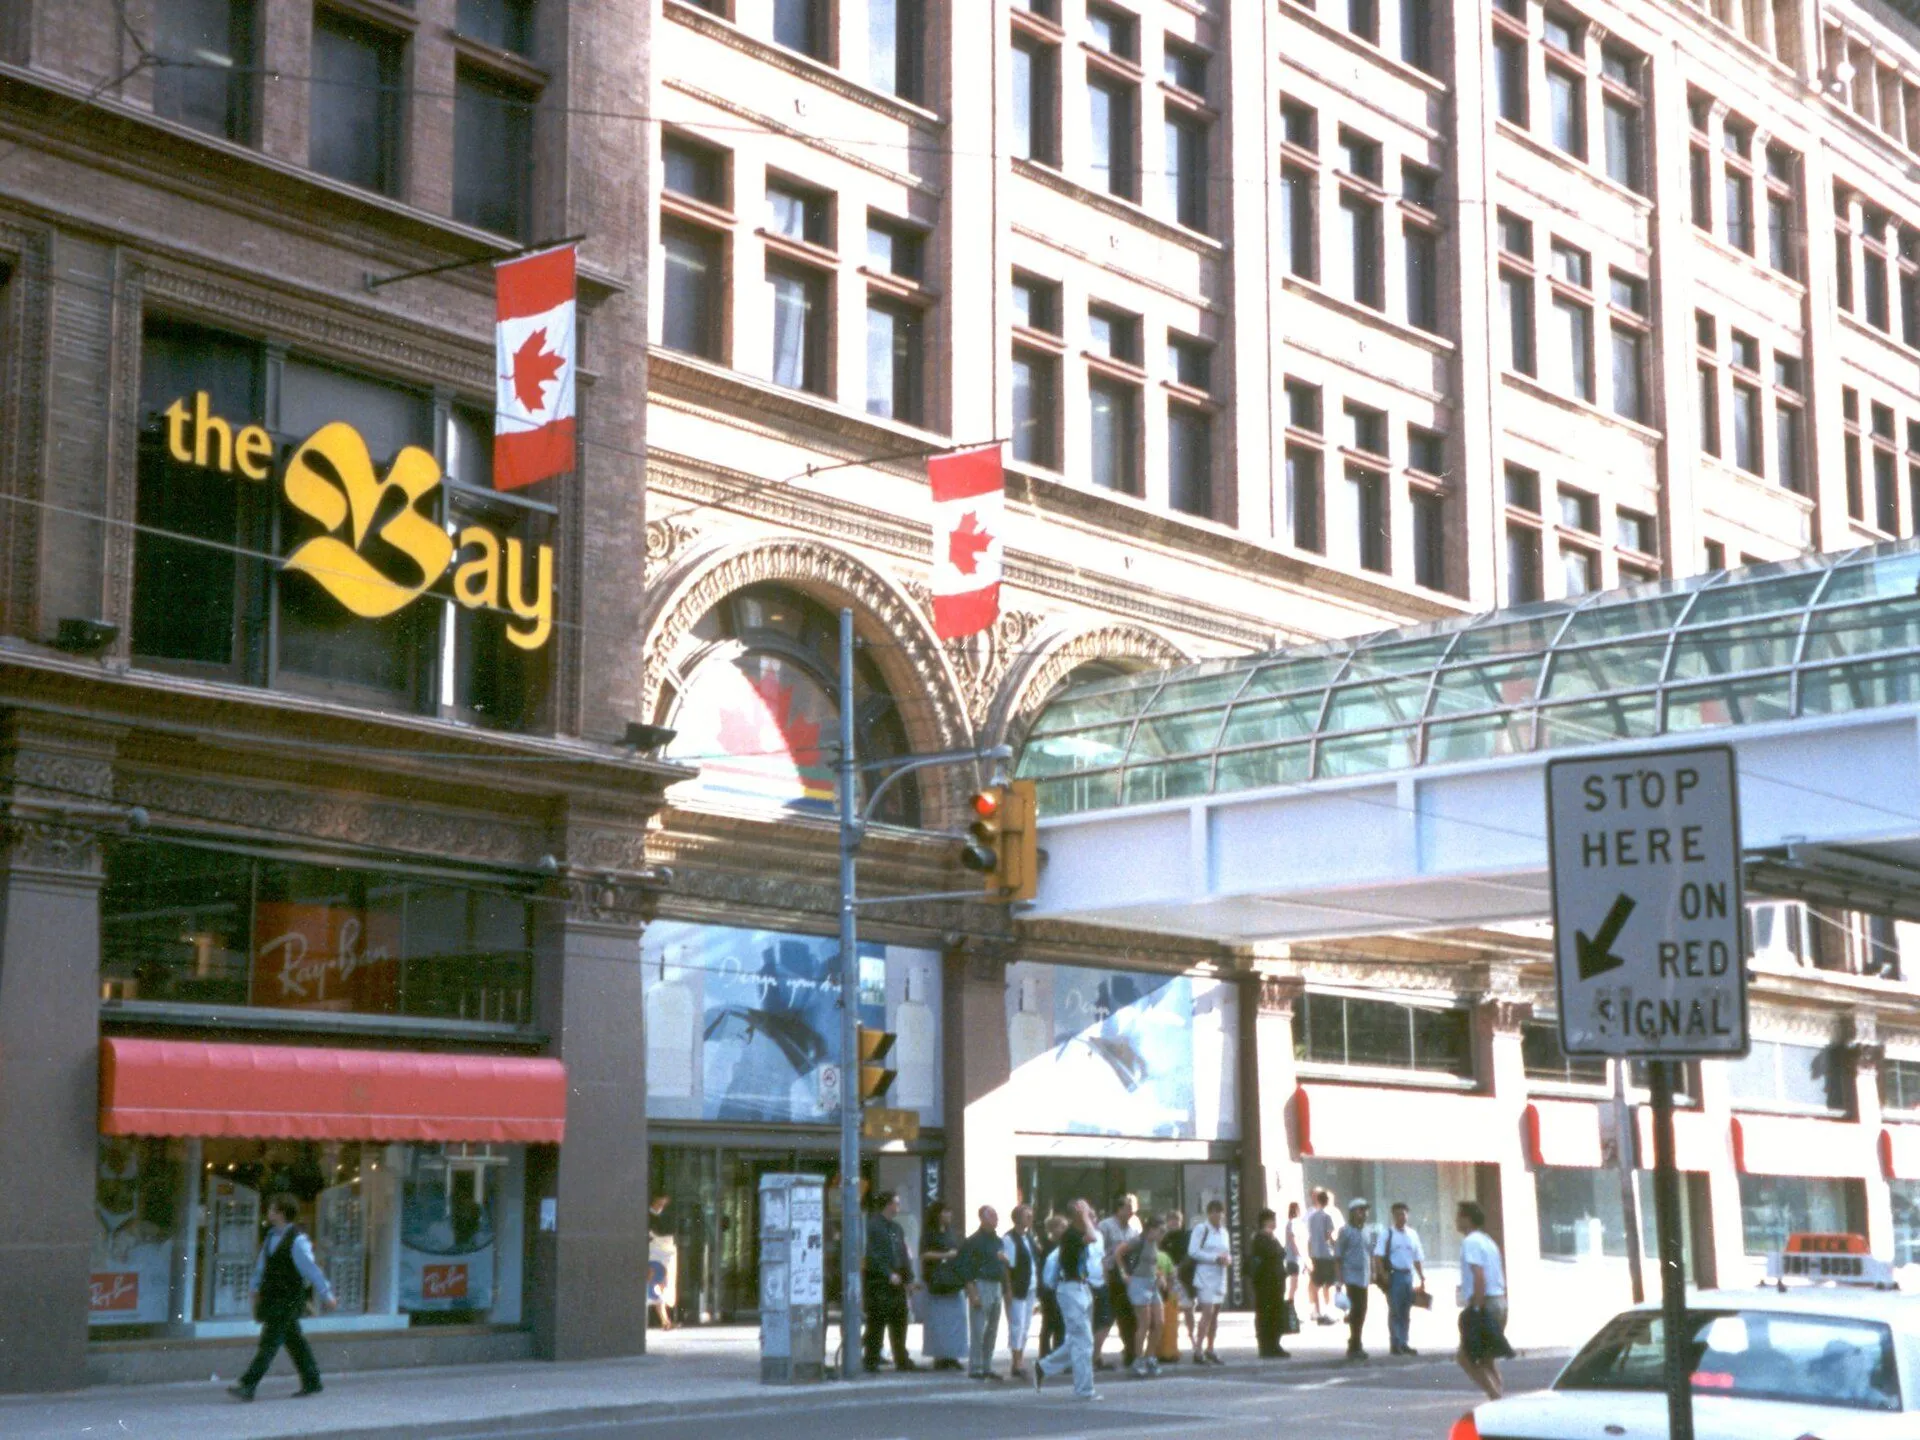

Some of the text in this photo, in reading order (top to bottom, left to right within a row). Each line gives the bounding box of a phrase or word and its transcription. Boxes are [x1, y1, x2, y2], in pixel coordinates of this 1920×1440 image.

[164, 390, 553, 650] the Bay
[1582, 767, 1699, 812] STOP
[1582, 825, 1705, 868] HERE
[1679, 881, 1727, 921] ON
[1658, 939, 1729, 979] RED
[1597, 998, 1732, 1037] SIGNAL
